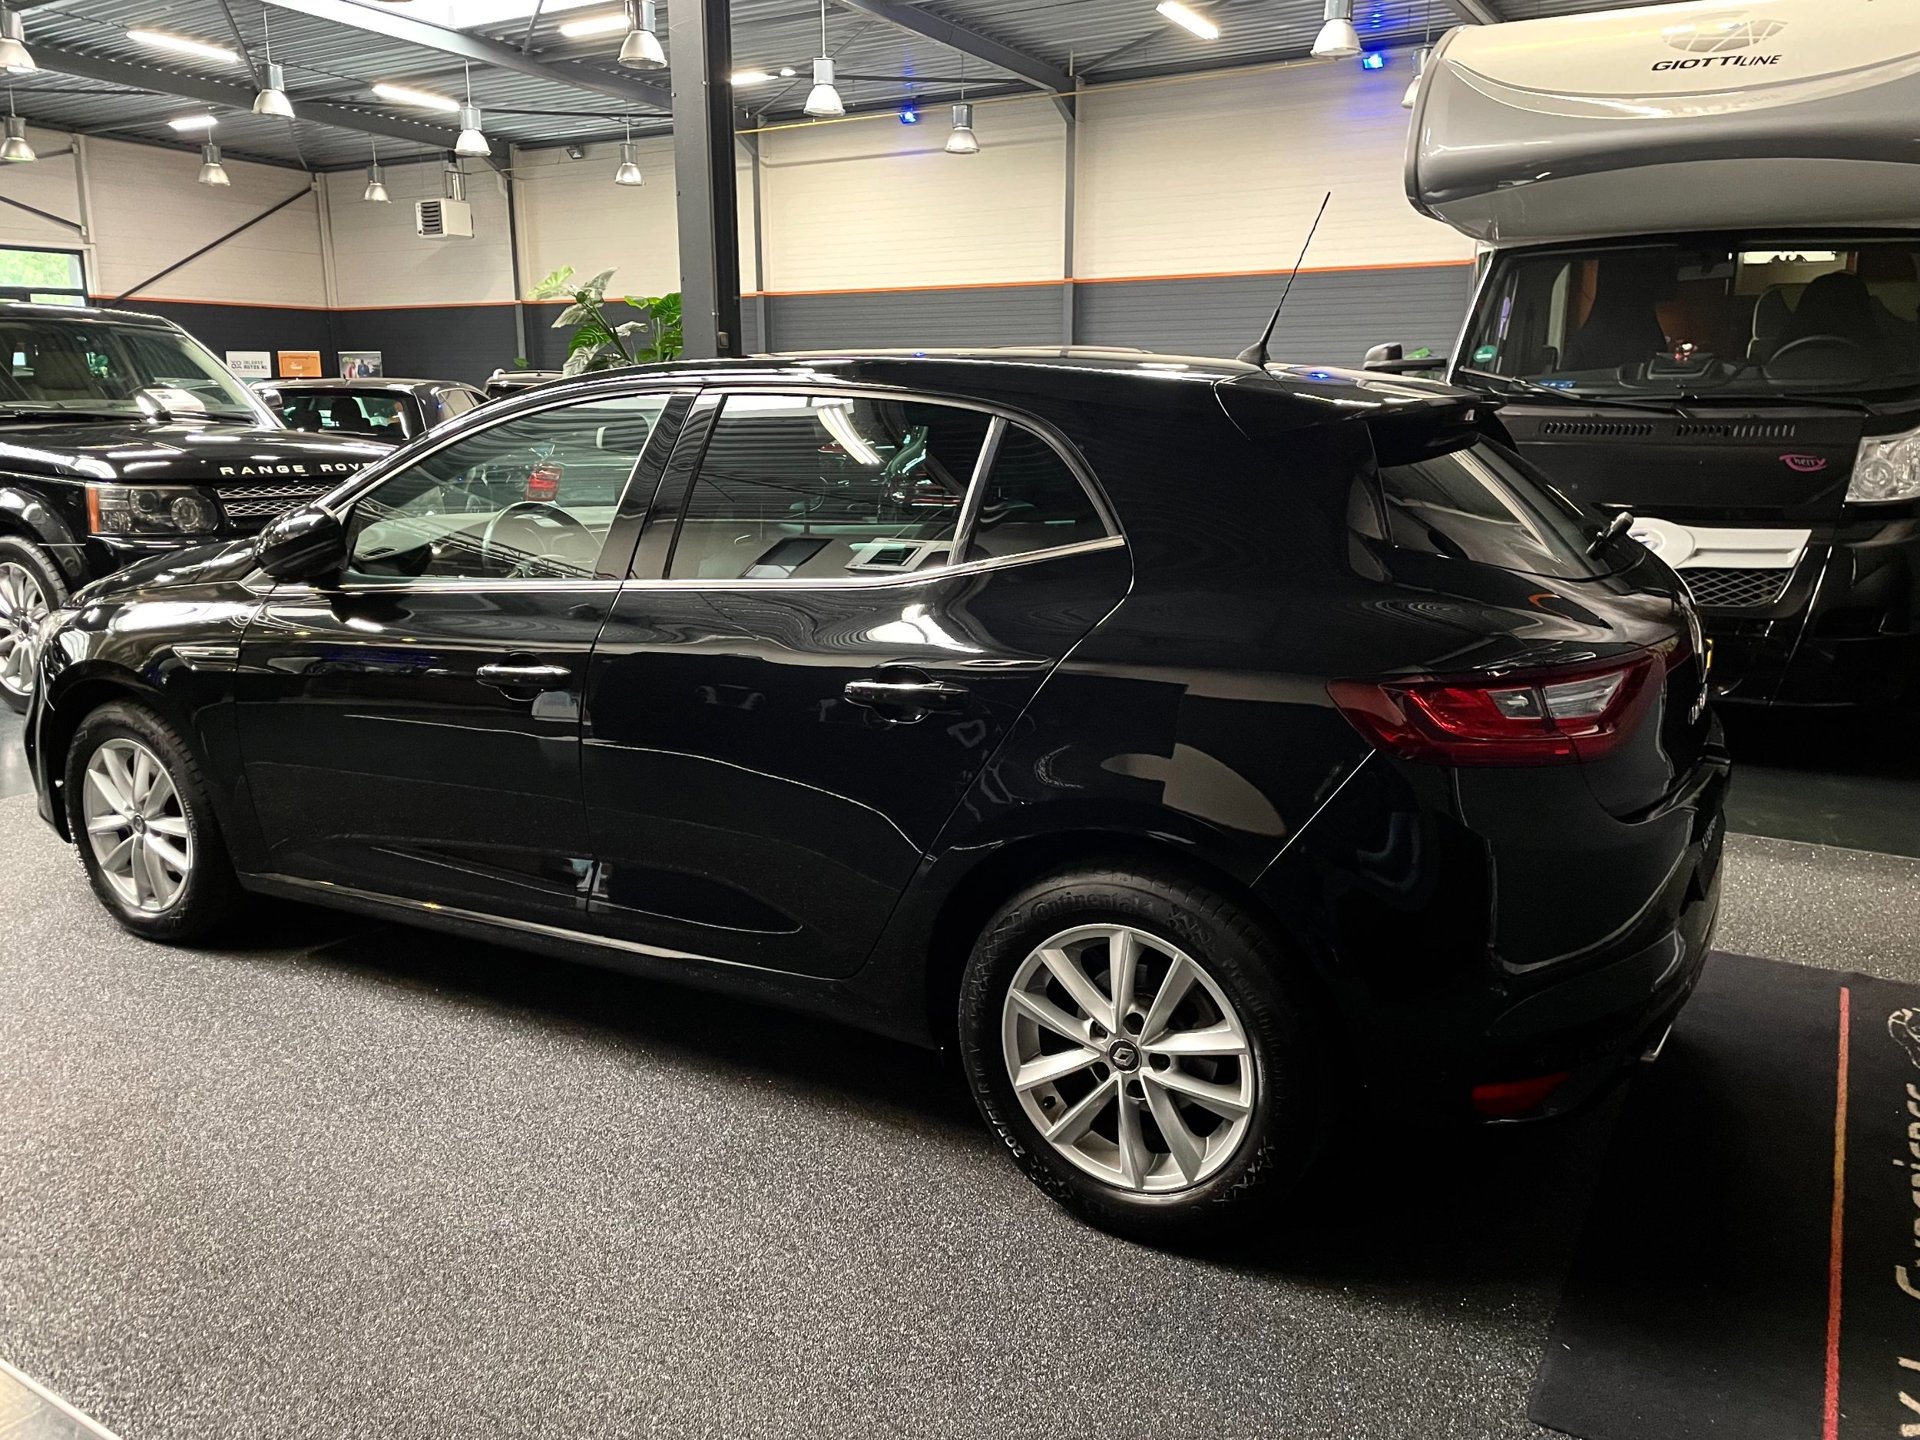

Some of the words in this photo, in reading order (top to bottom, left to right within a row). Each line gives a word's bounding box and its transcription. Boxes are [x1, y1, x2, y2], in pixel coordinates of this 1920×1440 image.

[1651, 54, 1783, 72] GIOTTILINE
[219, 464, 306, 476] RANGE
[319, 462, 374, 473] ROV
